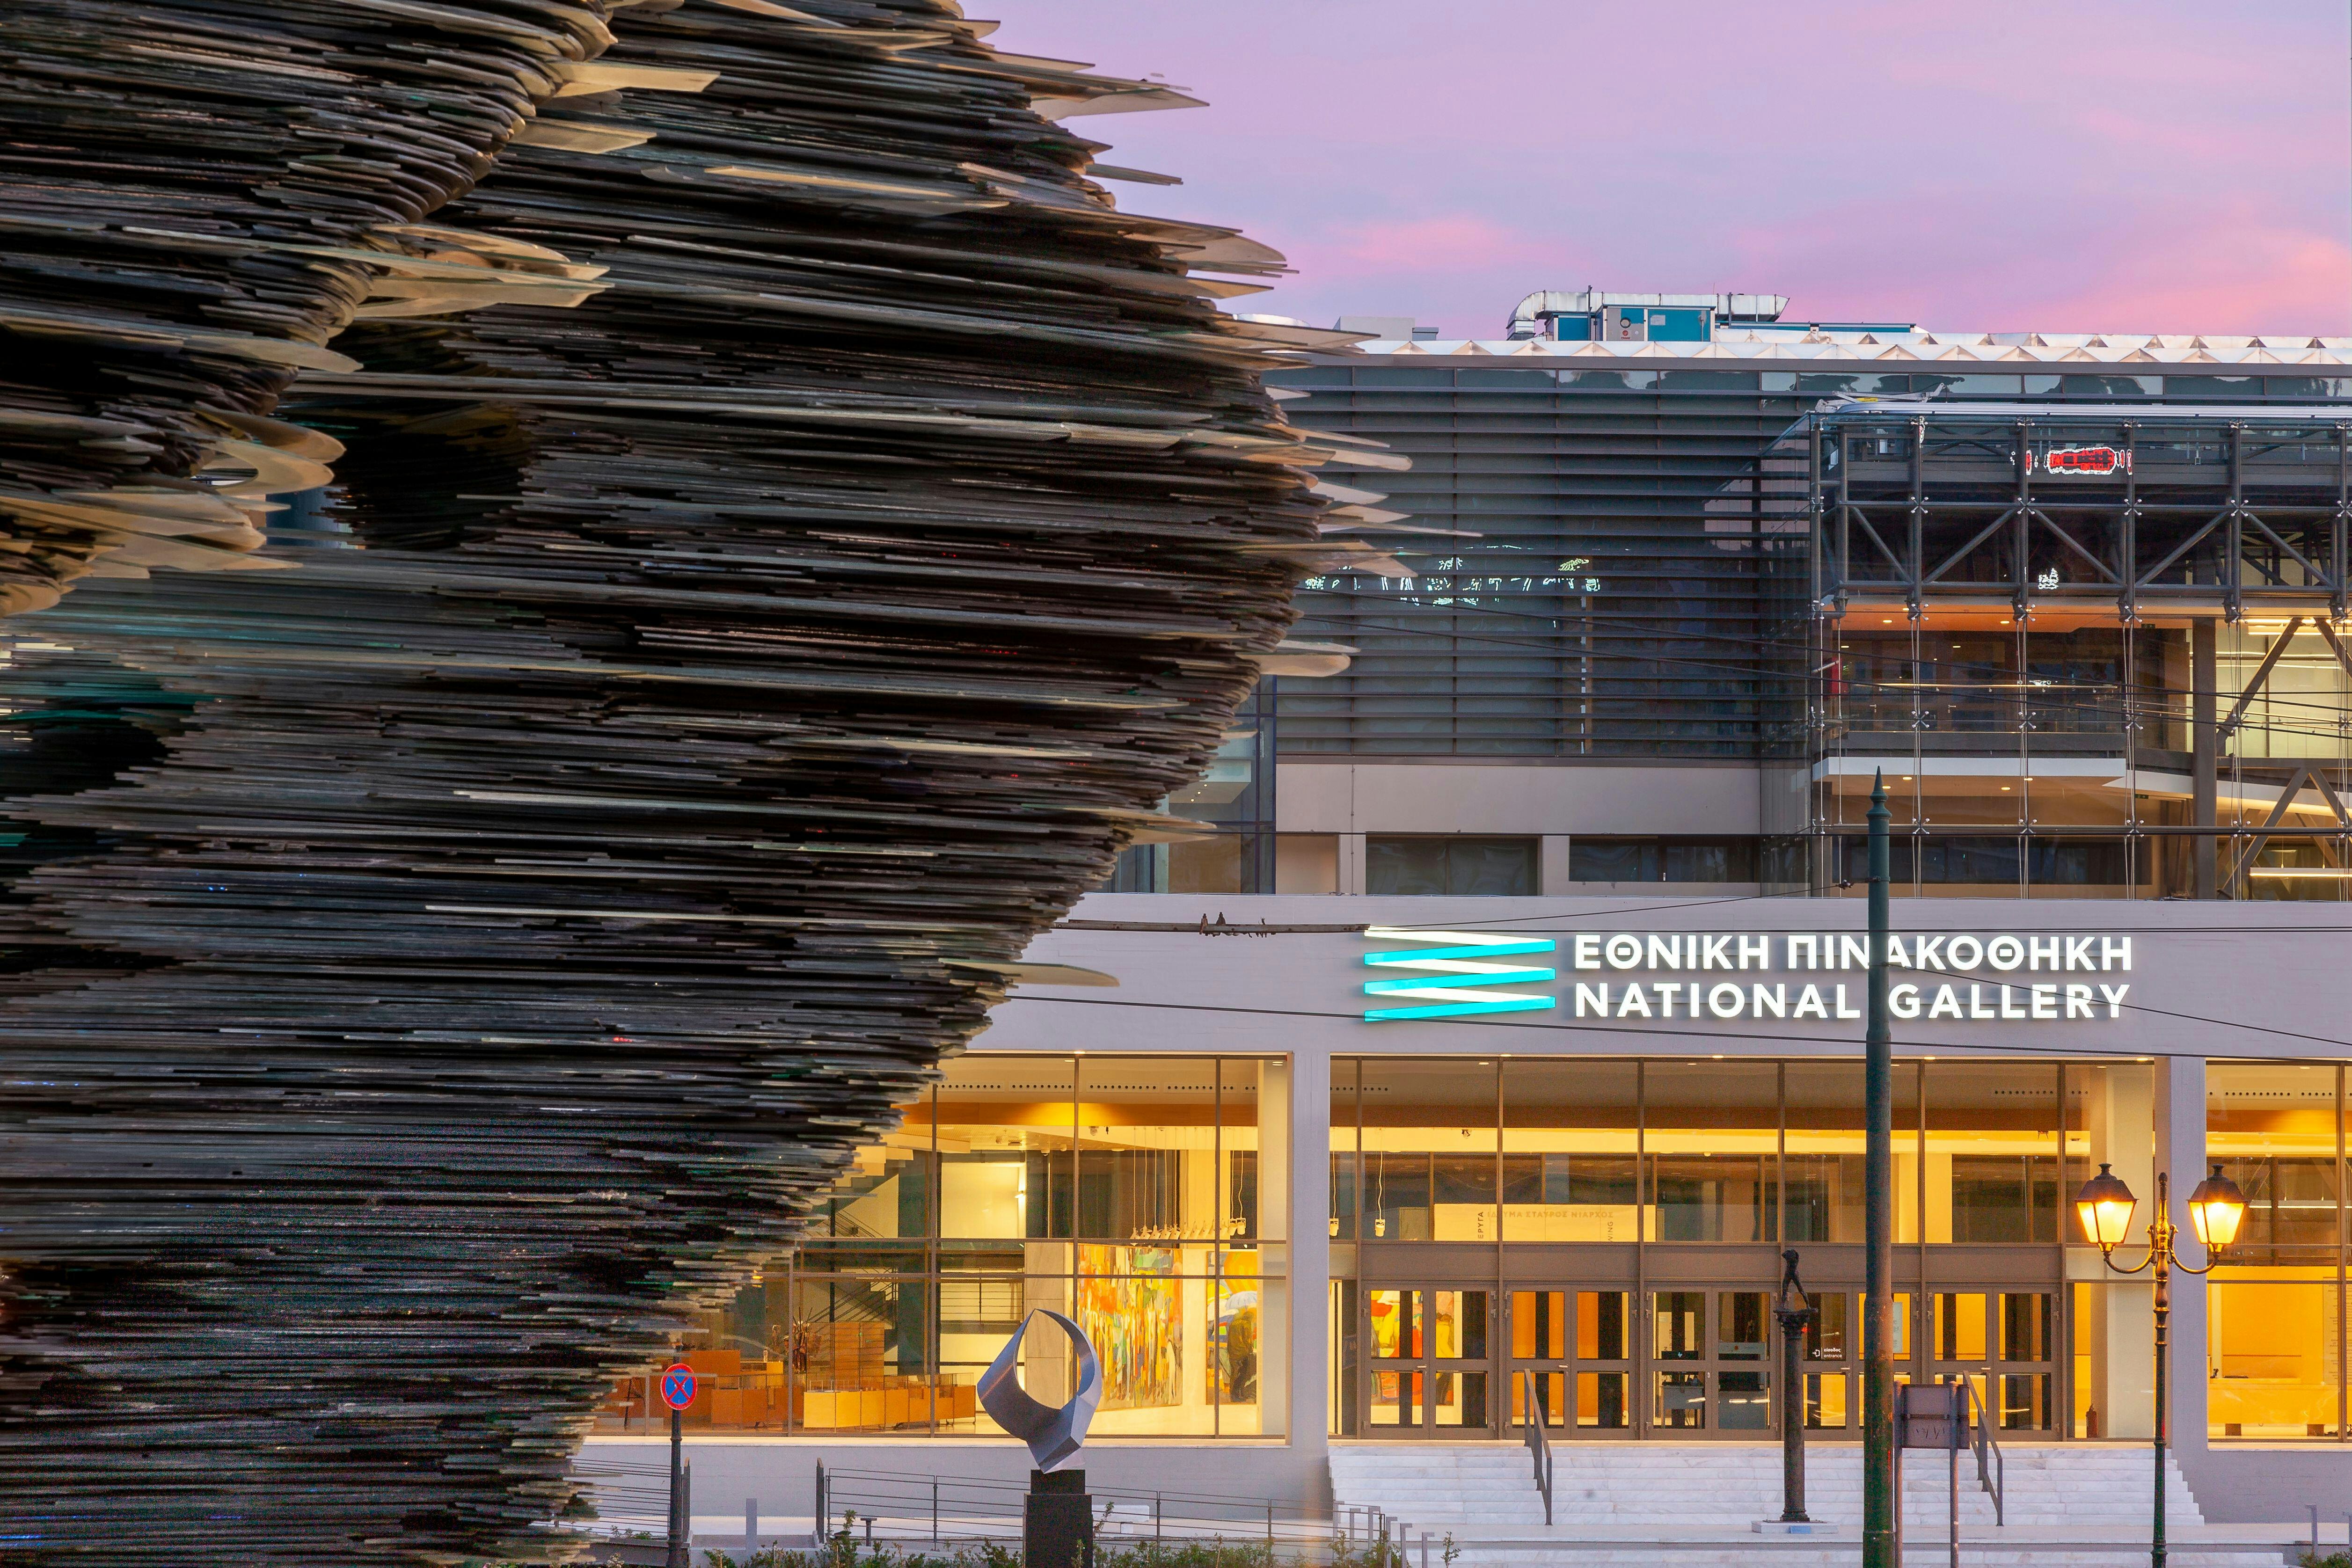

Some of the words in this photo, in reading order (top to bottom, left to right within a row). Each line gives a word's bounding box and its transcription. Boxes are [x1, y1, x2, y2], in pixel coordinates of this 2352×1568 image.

[1575, 934, 1769, 970] ΕΘΝΙΚΗ
[1788, 934, 2132, 970] ΠΙΝΑΚΟΘΗΚΗ
[1576, 983, 1861, 1018] NATIONAL
[1888, 984, 2130, 1018] GALLERY
